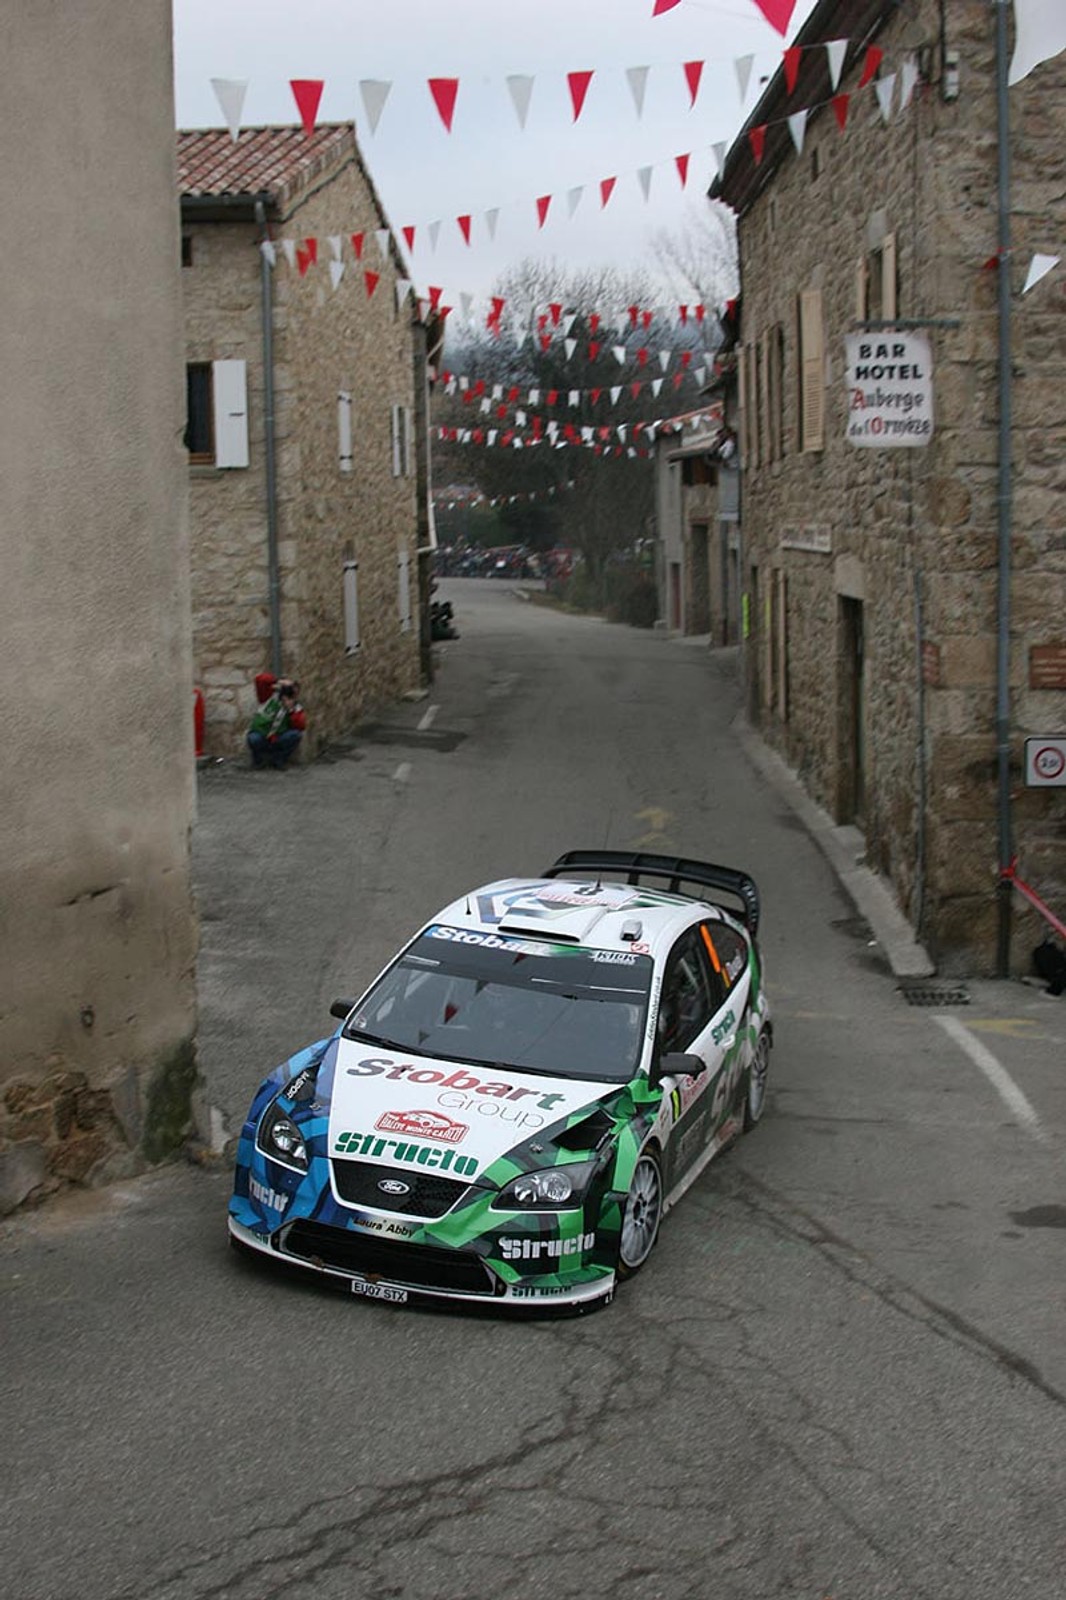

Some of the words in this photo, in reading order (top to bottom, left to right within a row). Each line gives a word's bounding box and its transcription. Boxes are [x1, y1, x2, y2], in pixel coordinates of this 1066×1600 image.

[860, 344, 905, 358] BAR
[856, 364, 923, 380] HOTEL
[850, 387, 924, 413] Auberge
[346, 1057, 566, 1111] Stobart
[437, 1091, 545, 1129] Group
[386, 1223, 415, 1238] Abby
[354, 1282, 380, 1297] EU07
[383, 1288, 405, 1302] STX
